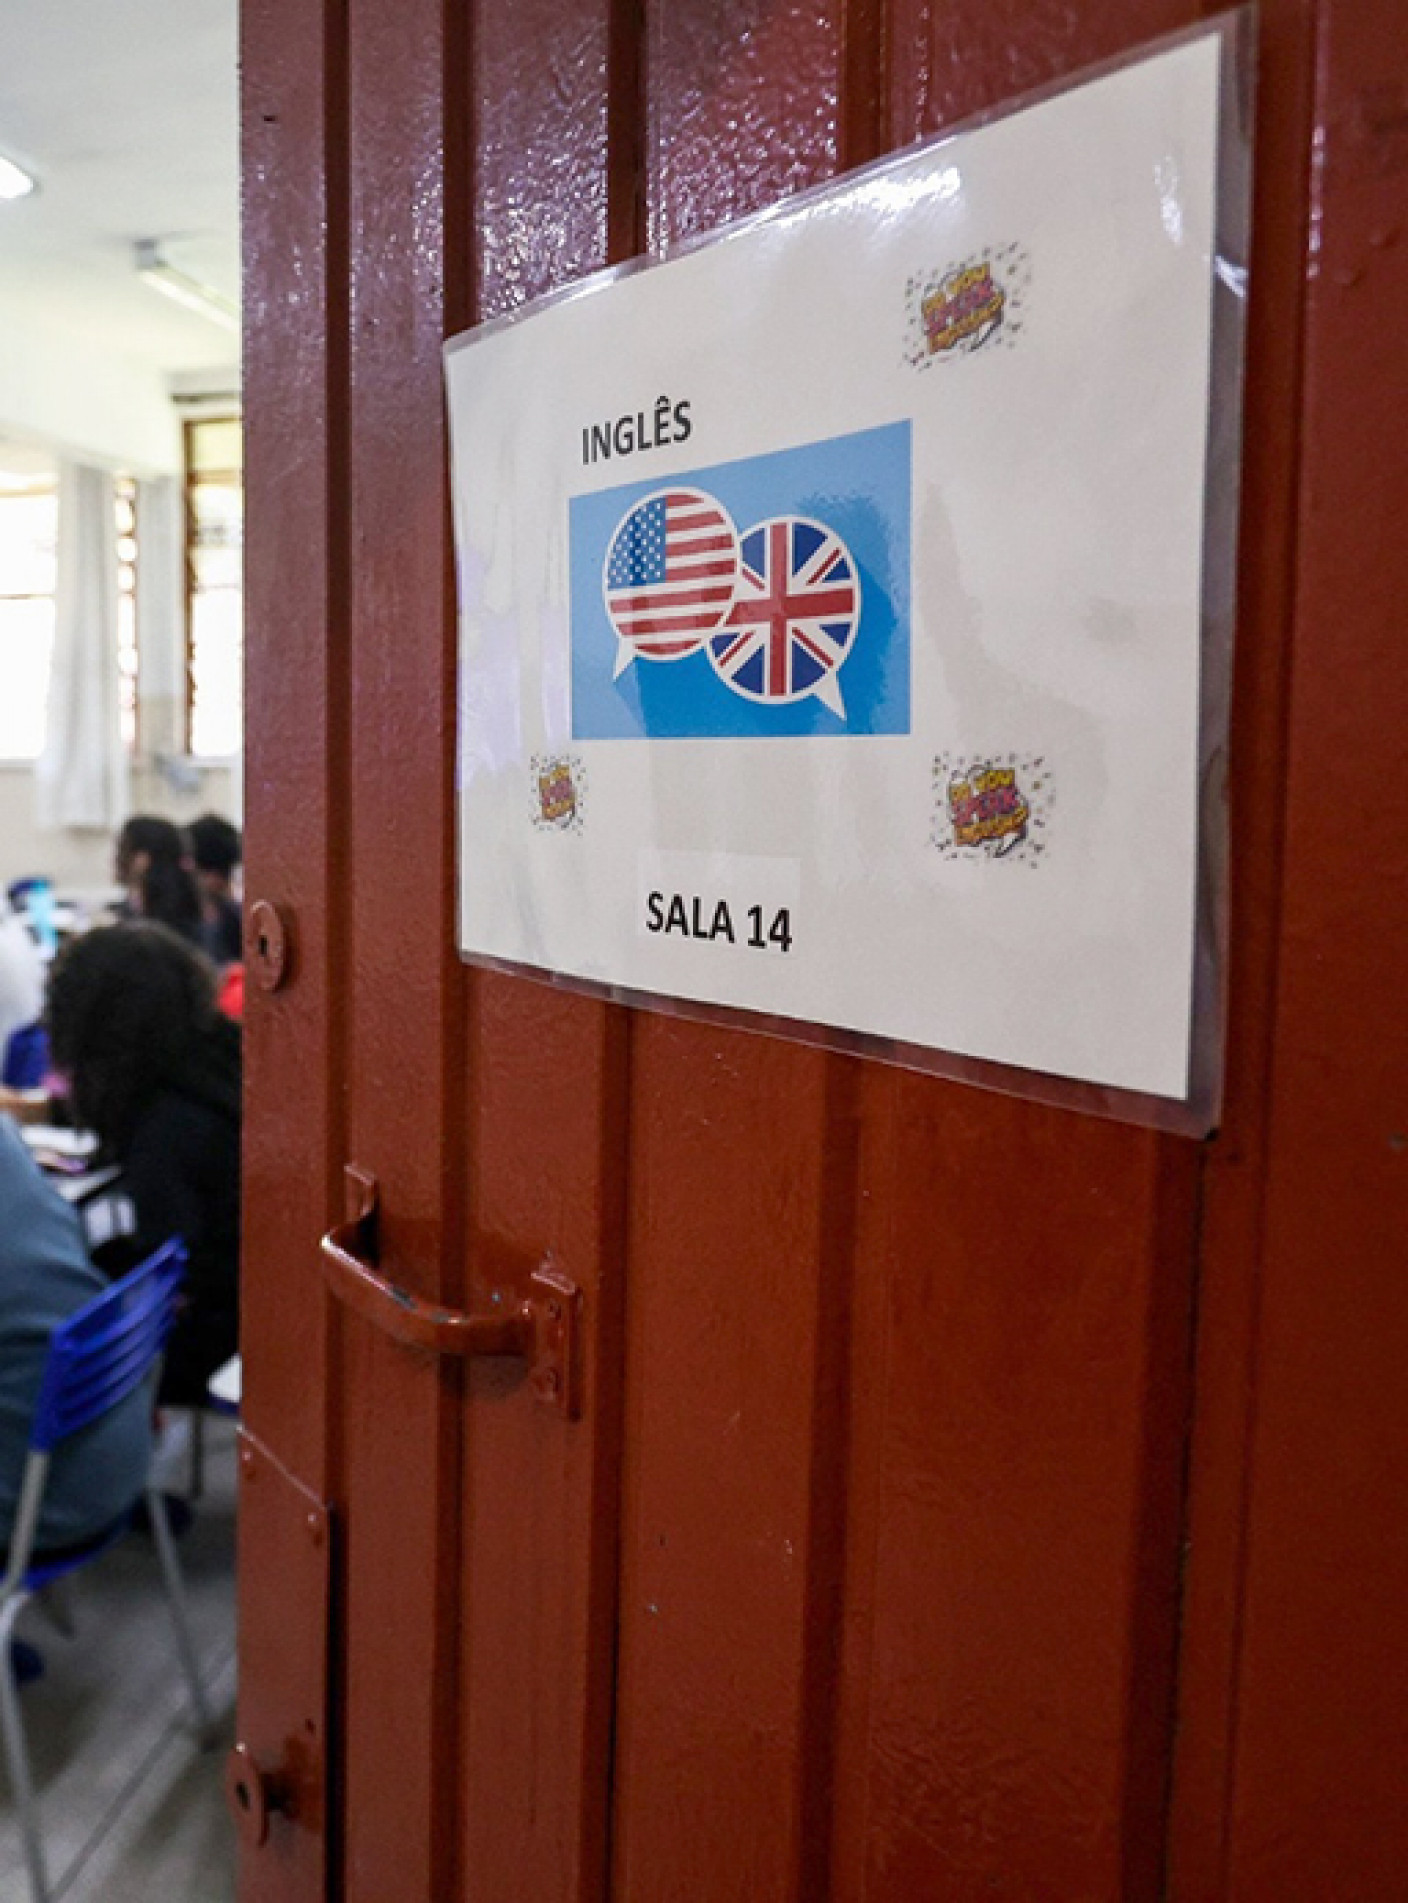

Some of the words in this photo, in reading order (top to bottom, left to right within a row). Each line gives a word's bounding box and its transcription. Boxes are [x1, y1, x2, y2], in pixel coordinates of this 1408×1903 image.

[582, 395, 691, 465] INGLÊS
[646, 890, 735, 944] SALA
[747, 904, 793, 952] 14
